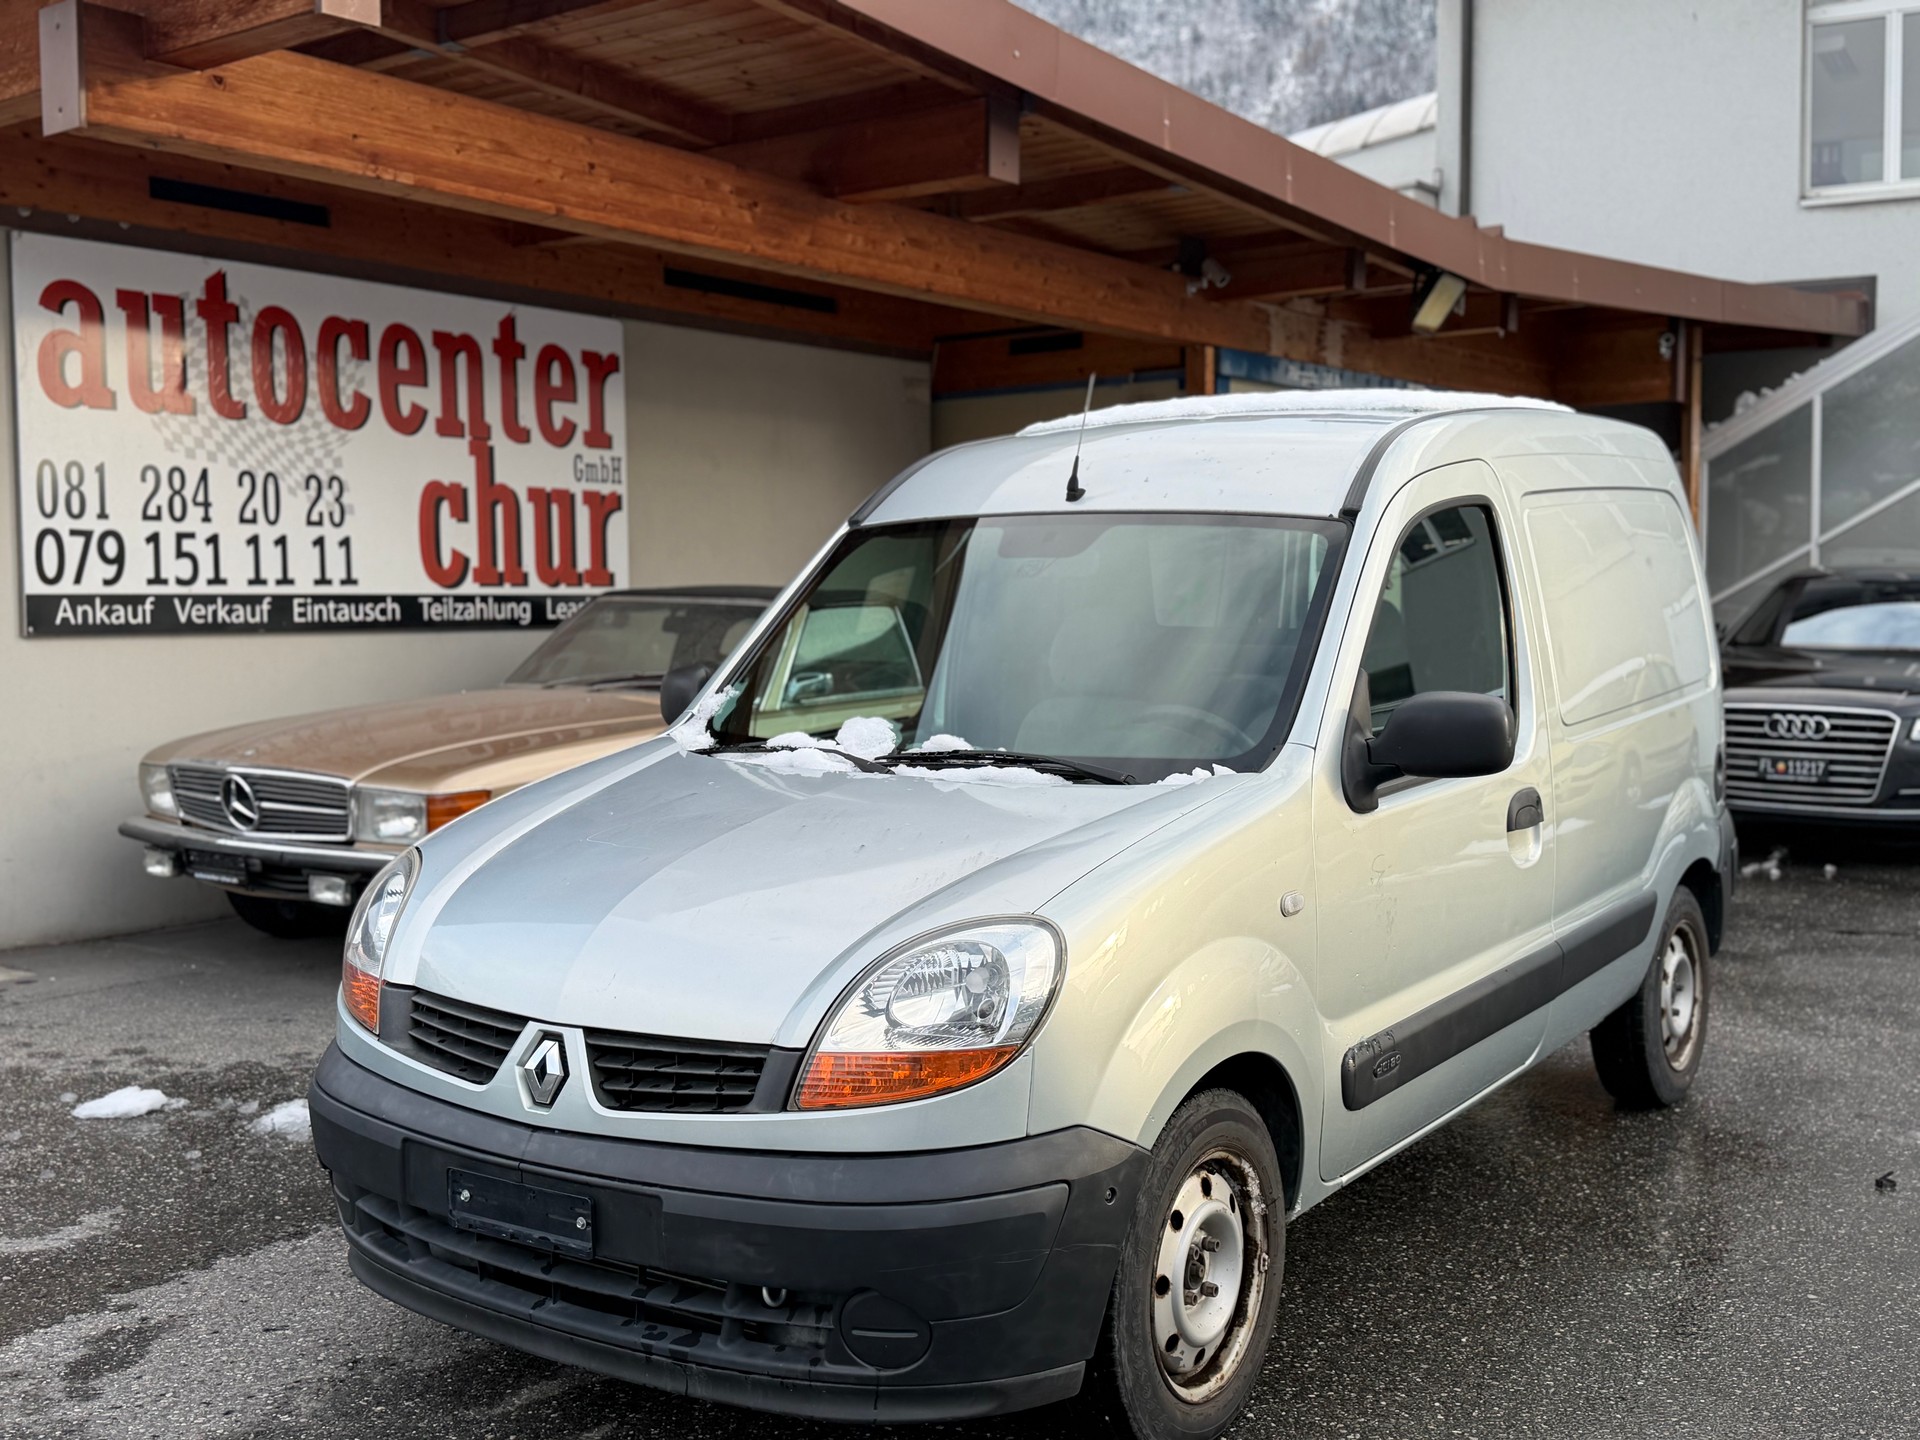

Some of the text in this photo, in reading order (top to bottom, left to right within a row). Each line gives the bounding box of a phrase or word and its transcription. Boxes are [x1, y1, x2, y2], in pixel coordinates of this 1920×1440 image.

[37, 269, 619, 448] autocenter
[36, 458, 346, 528] 081 284 20 23
[573, 454, 622, 484] GmbH
[419, 438, 622, 588] chur
[35, 527, 359, 586] 079 151 11 11
[55, 597, 155, 625] Ankauf
[173, 597, 272, 624] Verkauf
[292, 597, 401, 624] Eintausch
[418, 597, 532, 625] Teilzahlung
[1759, 758, 1775, 774] FL
